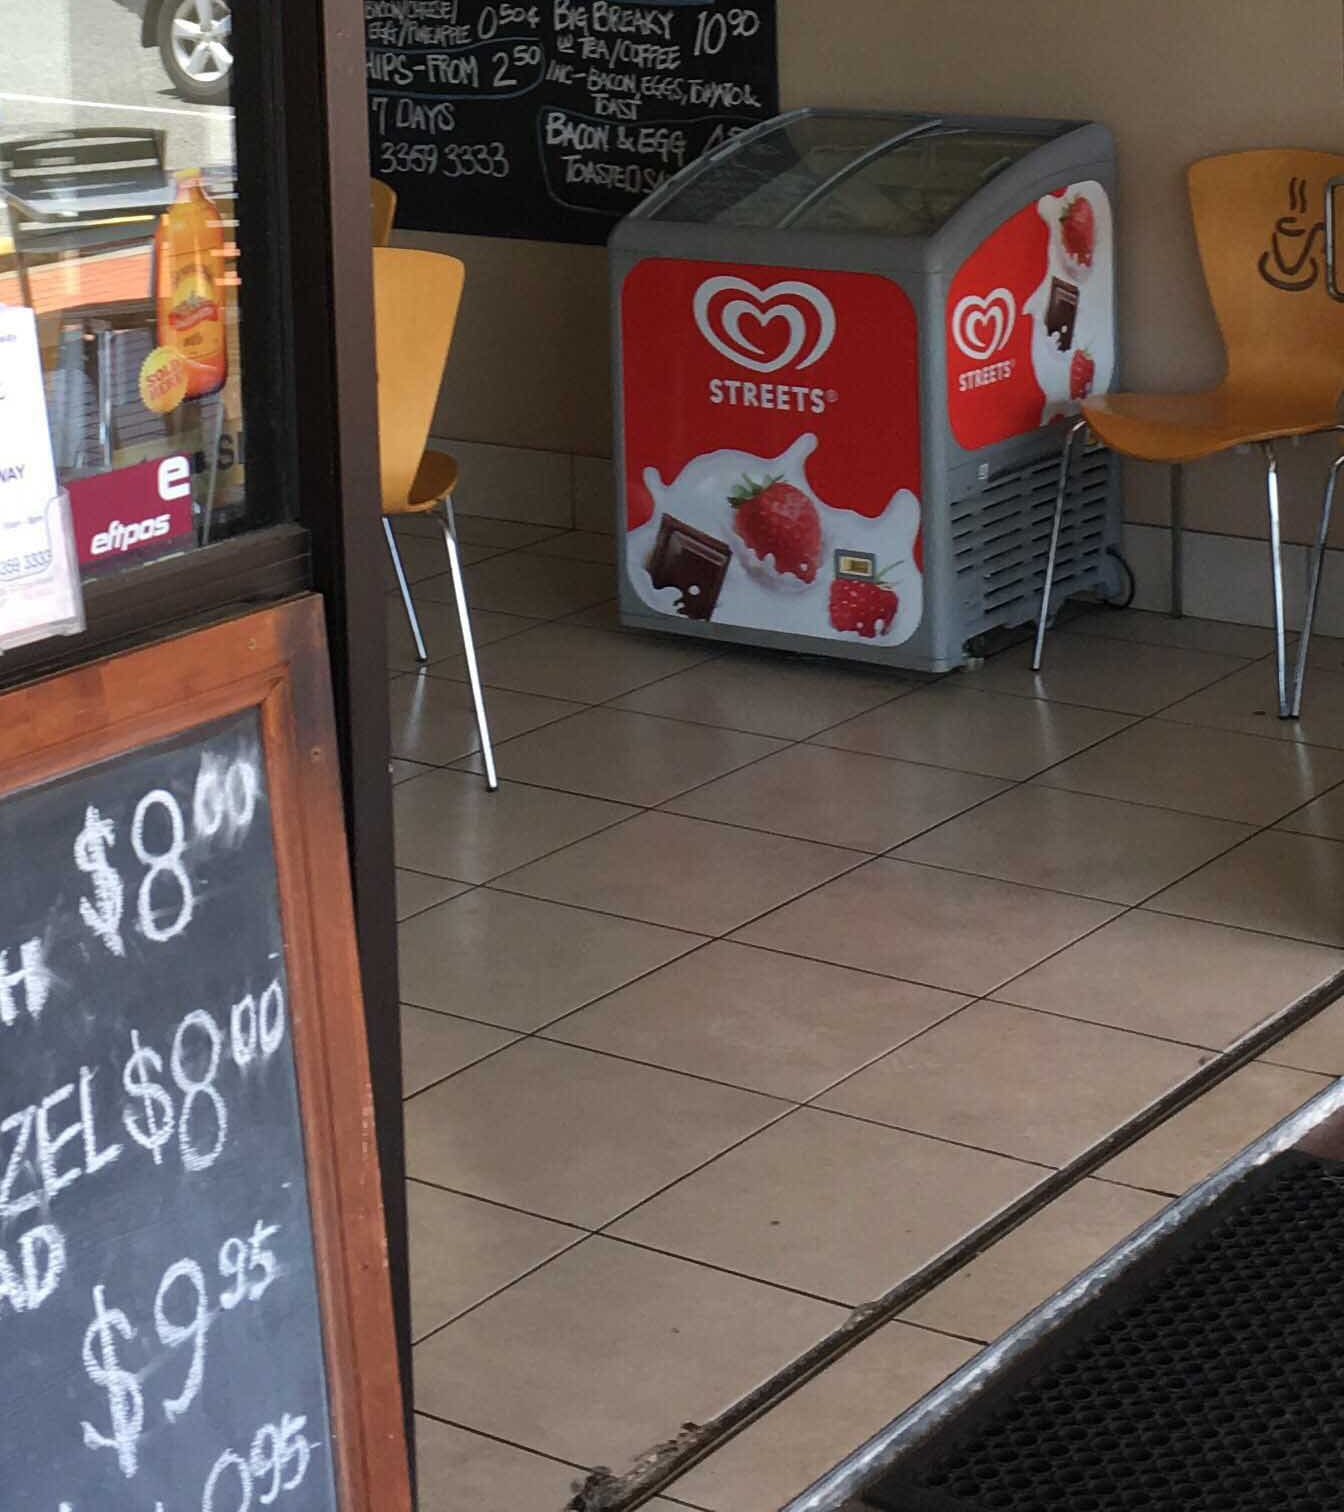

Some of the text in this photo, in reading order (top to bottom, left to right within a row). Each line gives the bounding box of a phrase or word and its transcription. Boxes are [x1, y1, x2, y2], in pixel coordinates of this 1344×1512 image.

[592, 0, 675, 40] BREAKY
[372, 97, 457, 136] 7 DAYS
[545, 112, 610, 152] BACON
[442, 142, 510, 178] 3333
[709, 377, 827, 415] STREETS
[958, 360, 1013, 393] STREETS
[90, 513, 172, 556] eftpos
